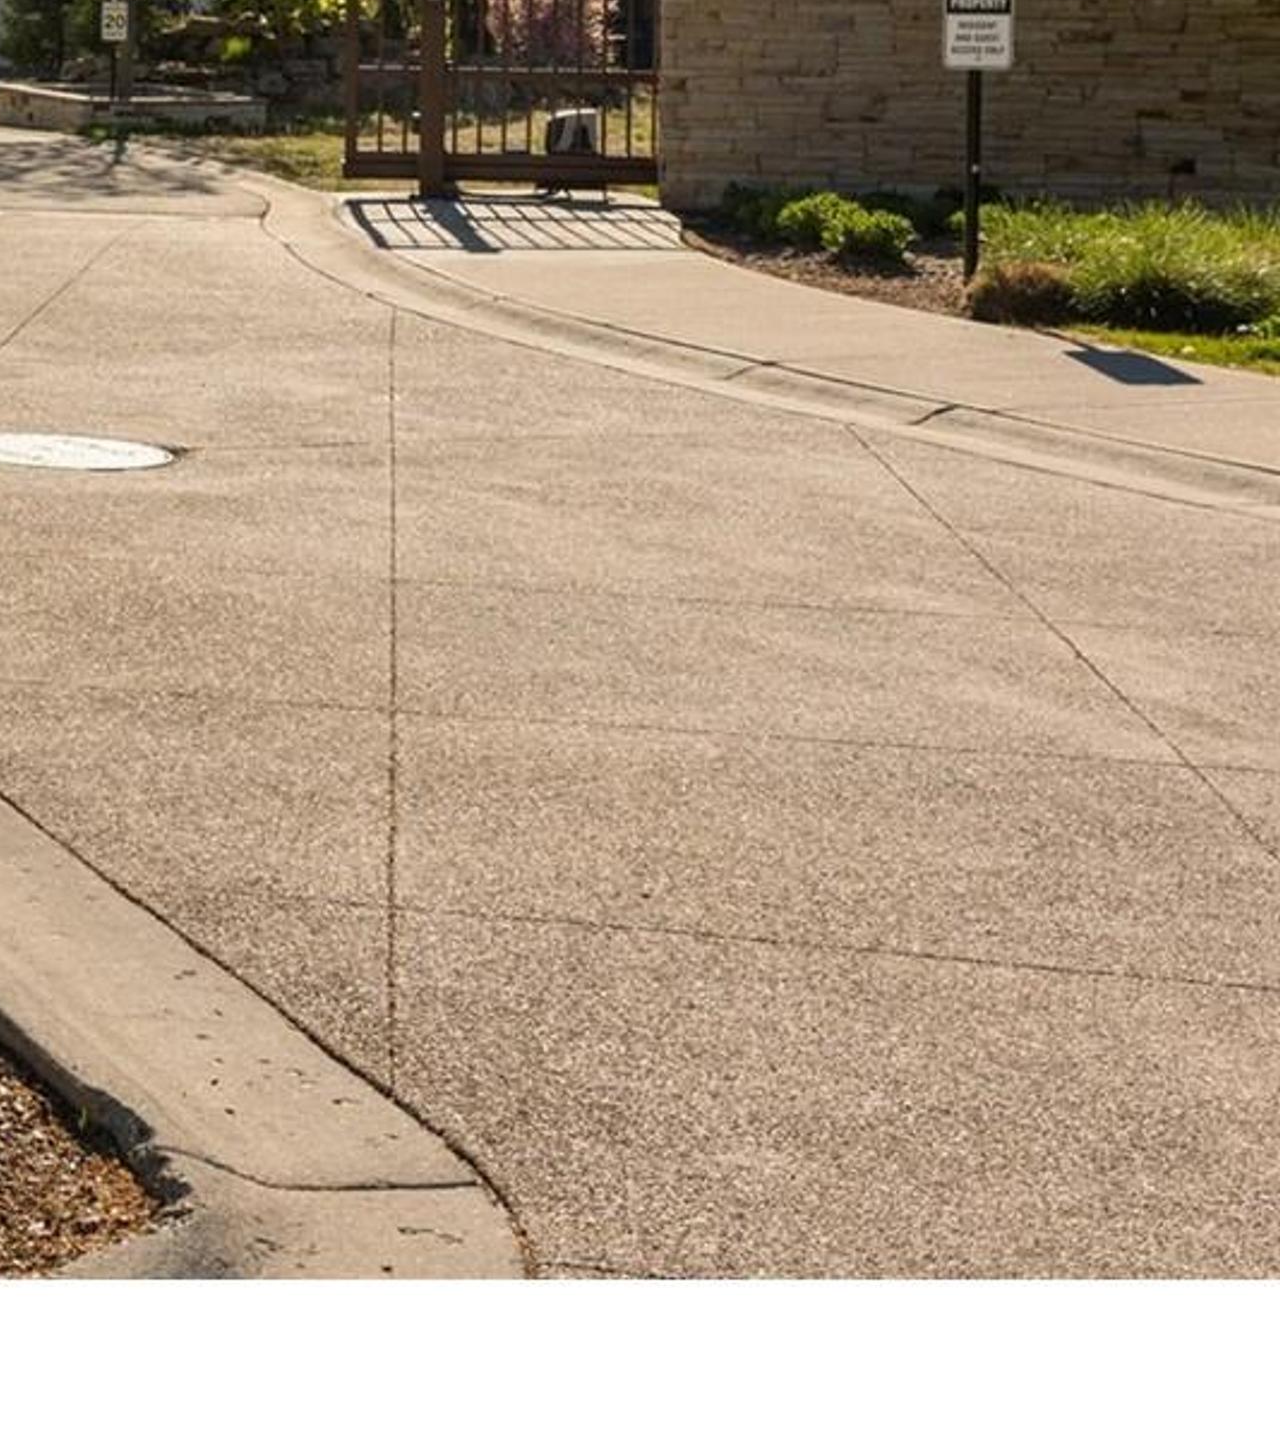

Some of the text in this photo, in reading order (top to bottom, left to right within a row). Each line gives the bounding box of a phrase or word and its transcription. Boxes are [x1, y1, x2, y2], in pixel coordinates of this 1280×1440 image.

[104, 13, 126, 30] 20
[955, 33, 1000, 42] AND GUEST
[951, 45, 1005, 54] ACCESS ONLY
